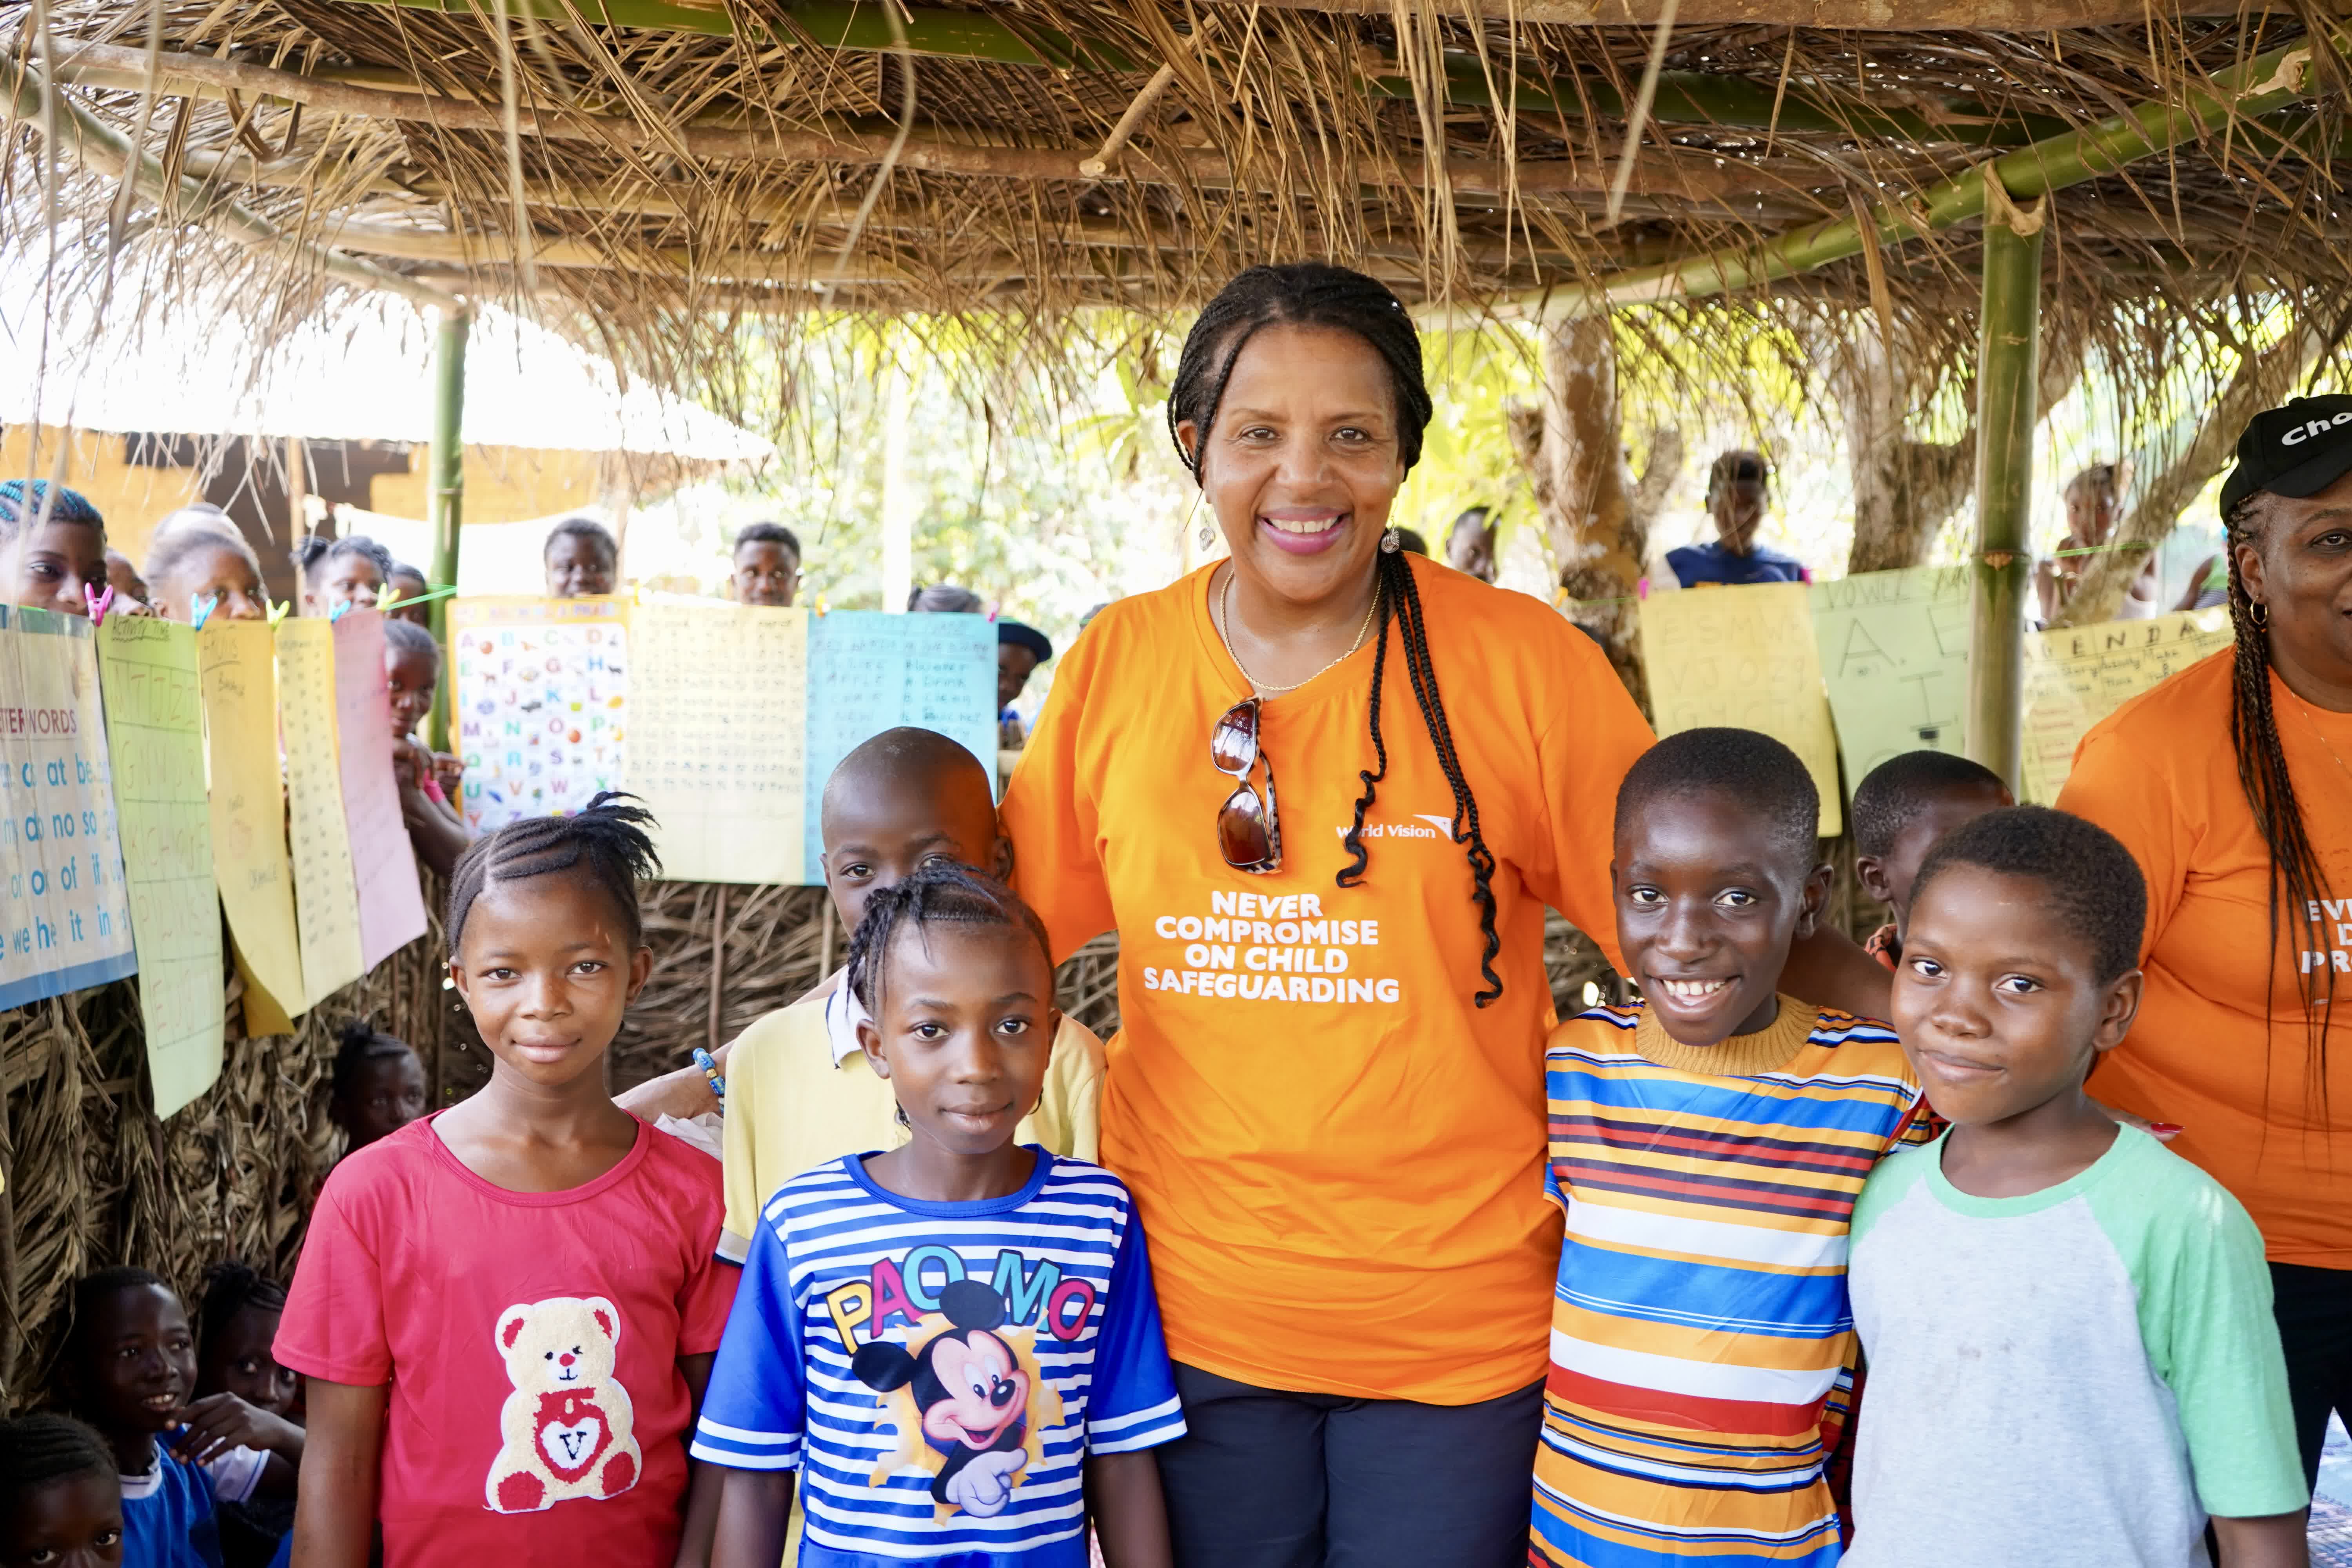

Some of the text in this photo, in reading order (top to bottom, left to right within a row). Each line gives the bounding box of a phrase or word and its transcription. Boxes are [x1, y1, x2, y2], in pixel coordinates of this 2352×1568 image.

[589, 657, 603, 671] H
[505, 690, 517, 706] J
[546, 689, 561, 703] K
[590, 686, 602, 702] L
[463, 716, 605, 737] M N O P
[550, 749, 563, 764] S
[594, 747, 606, 762] T
[47, 756, 68, 786] at
[465, 777, 609, 799] U V W X
[53, 813, 75, 838] no
[82, 810, 97, 836] so
[468, 811, 482, 827] Y
[1336, 824, 1436, 839] Wrld Vision
[61, 856, 77, 891] of
[1211, 890, 1323, 919] NEVER
[12, 927, 31, 954] we
[69, 909, 84, 942] it
[97, 903, 111, 936] in
[1155, 916, 1379, 945] COMPROMISE
[1185, 944, 1349, 974] ON CHILD
[2301, 950, 2352, 974] PR
[1144, 967, 1400, 1004] SAFEGUARDING
[826, 1244, 1096, 1358] PAO MO
[559, 1431, 587, 1460] V
